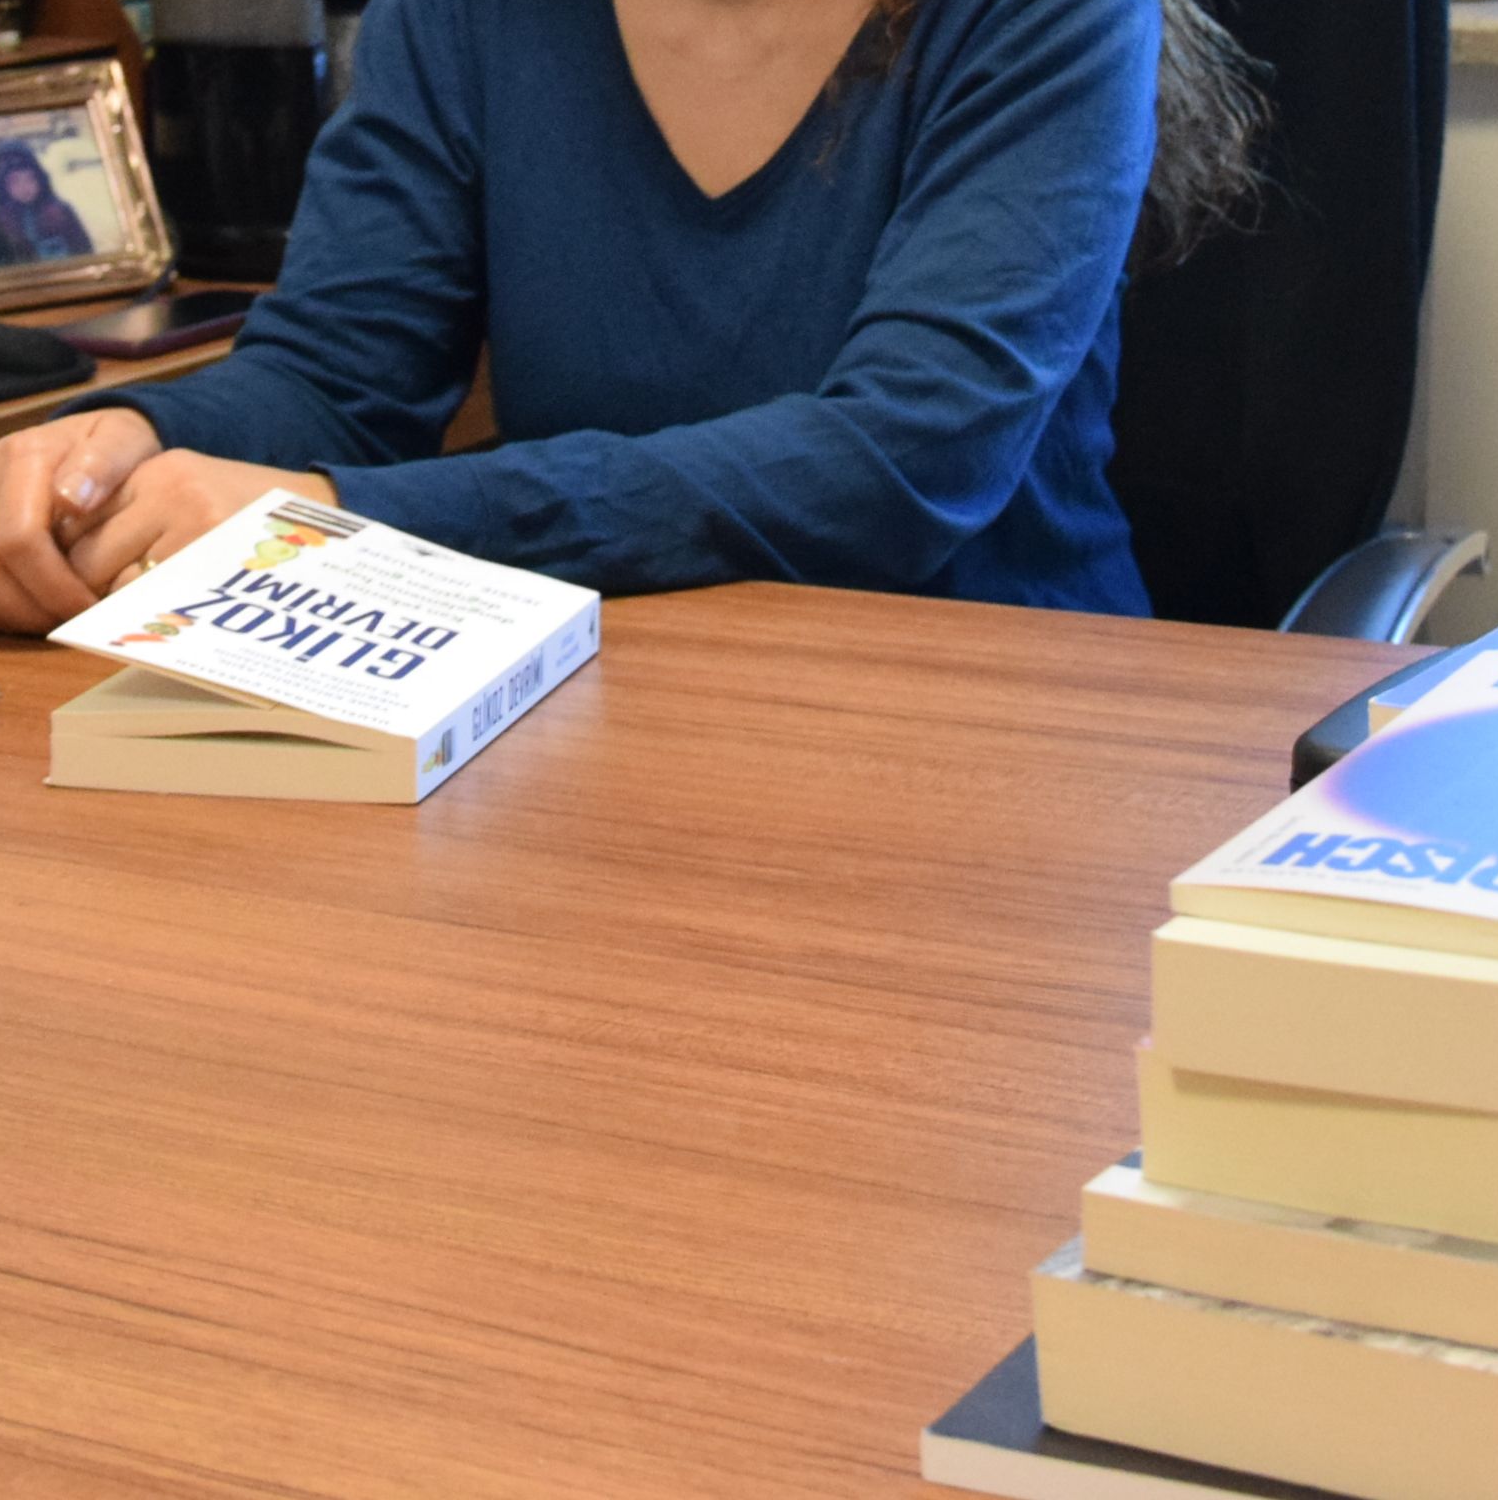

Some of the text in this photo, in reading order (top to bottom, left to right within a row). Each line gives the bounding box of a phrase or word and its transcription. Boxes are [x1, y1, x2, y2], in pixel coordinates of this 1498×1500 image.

[173, 592, 426, 681] GLİKOZ
[218, 567, 459, 650] DEVRİMİ
[472, 678, 502, 742] GLİKOZ
[508, 645, 543, 712] DEVRİMİ
